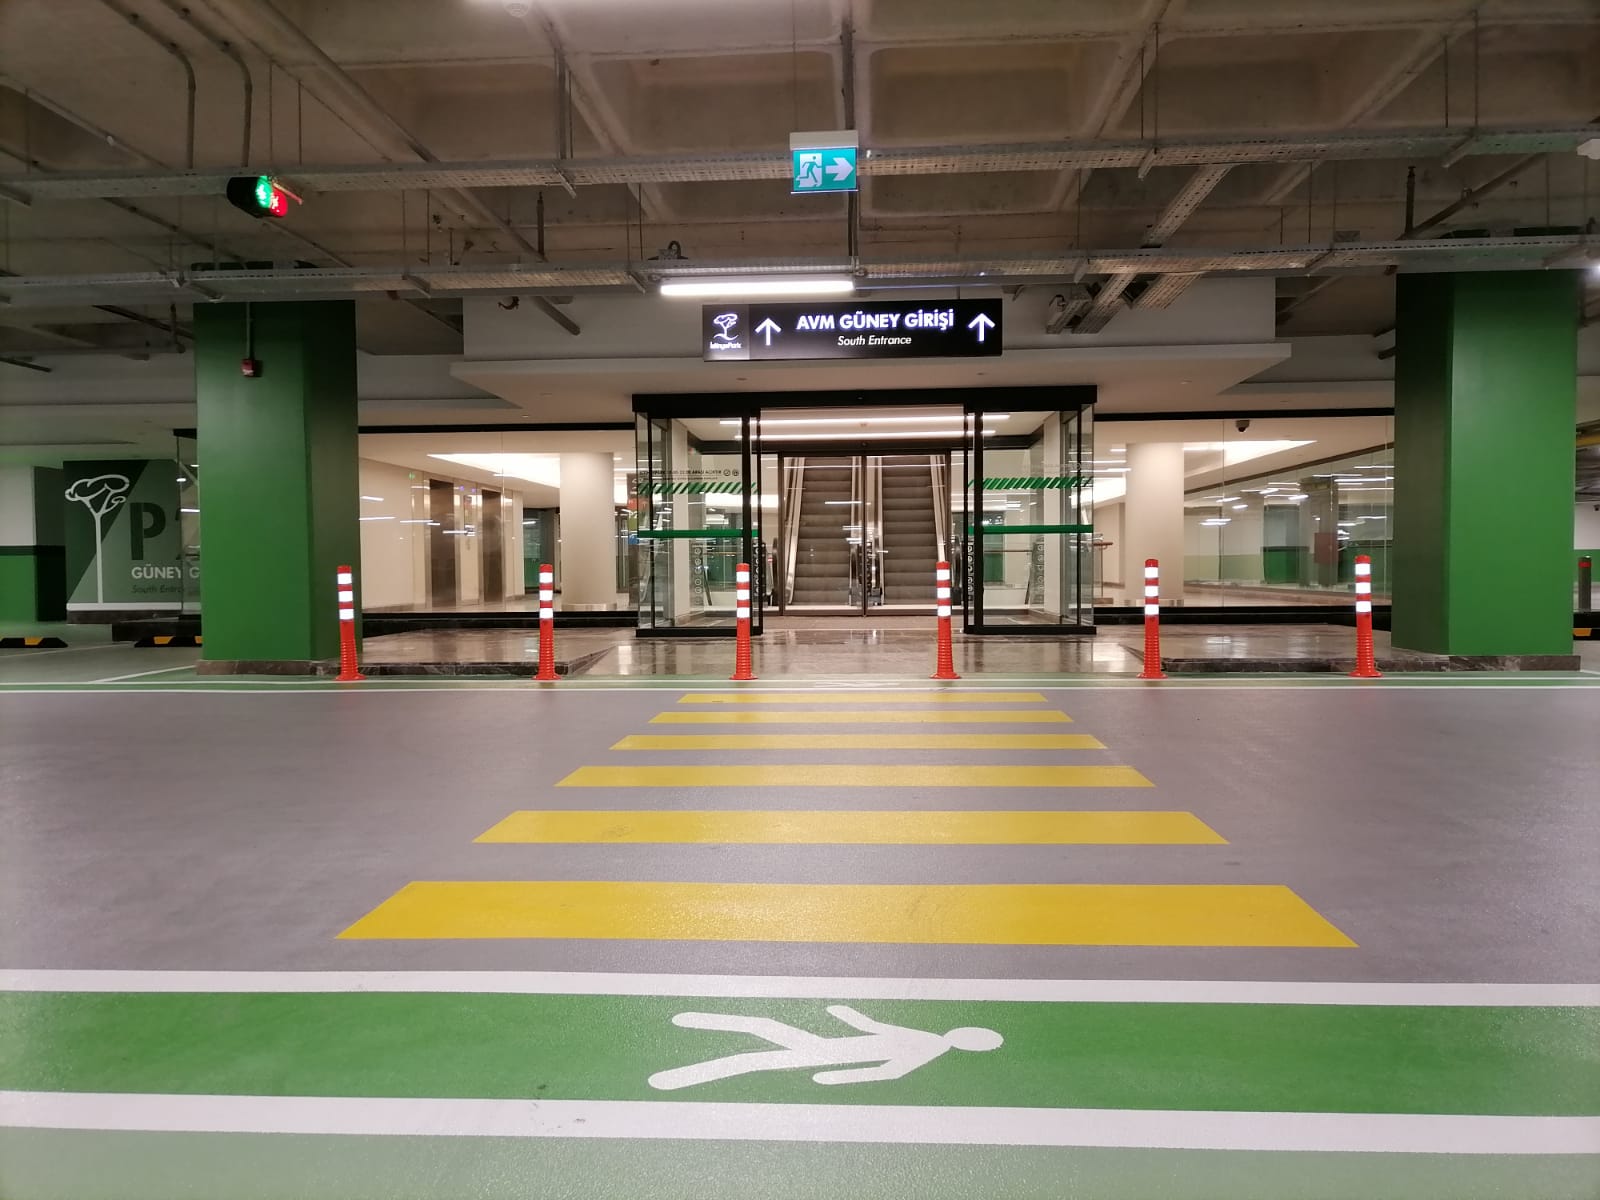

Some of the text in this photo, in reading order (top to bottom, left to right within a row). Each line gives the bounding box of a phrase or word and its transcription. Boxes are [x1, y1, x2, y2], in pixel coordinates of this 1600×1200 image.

[796, 308, 955, 331] AVM GÜNEY GİRİŞİ
[837, 335, 912, 347] South Entrance
[131, 563, 182, 580] GÜNEY
